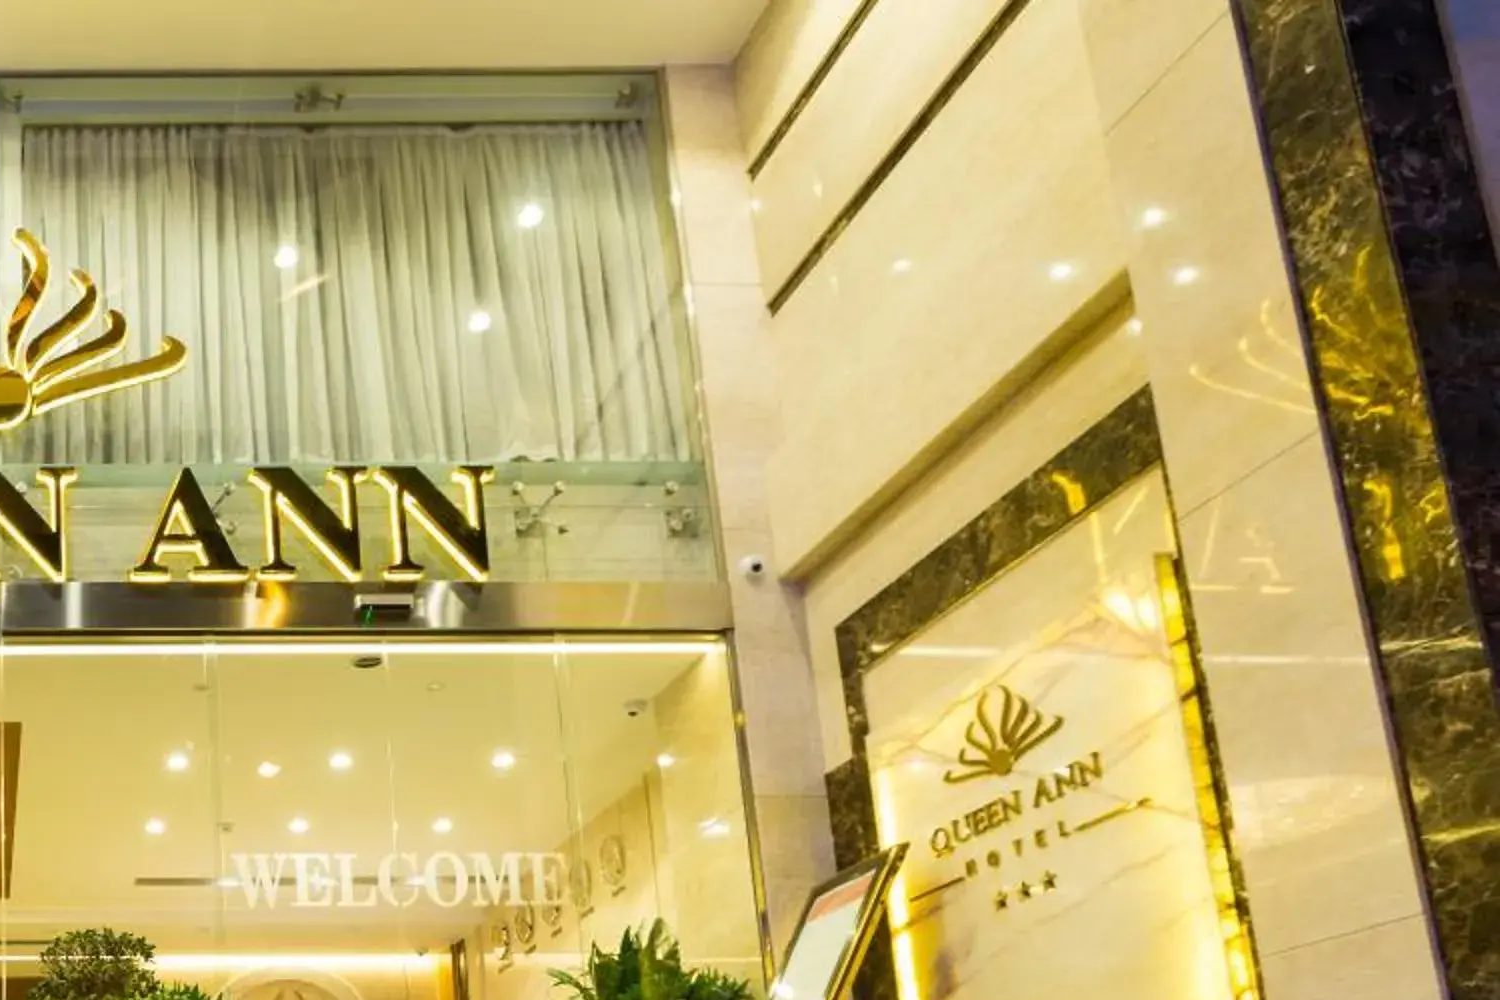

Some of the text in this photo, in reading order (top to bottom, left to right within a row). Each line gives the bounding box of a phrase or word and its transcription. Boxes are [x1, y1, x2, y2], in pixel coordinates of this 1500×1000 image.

[129, 465, 496, 583] ANN
[930, 751, 1103, 858] QUEEN ANN
[230, 851, 570, 909] WELCOME
[965, 820, 1071, 878] HOTEL
